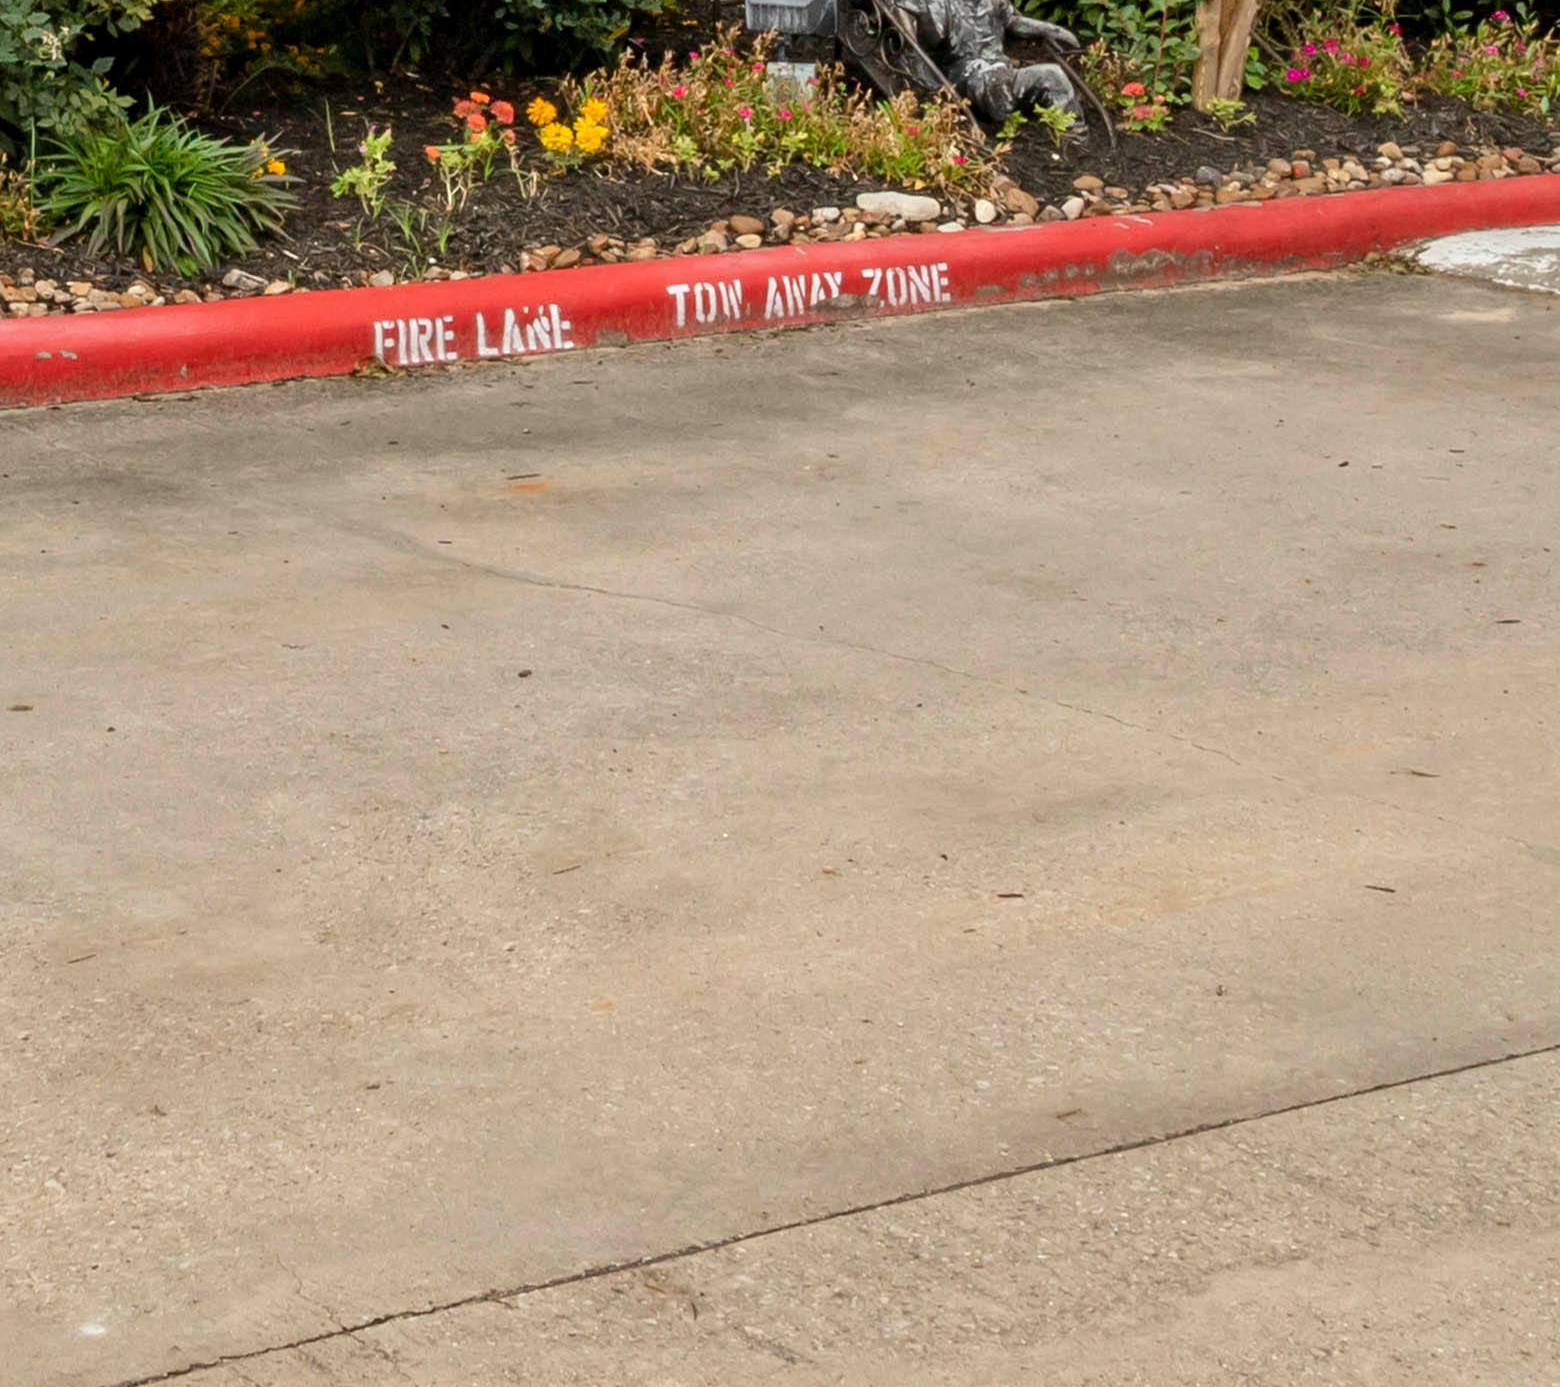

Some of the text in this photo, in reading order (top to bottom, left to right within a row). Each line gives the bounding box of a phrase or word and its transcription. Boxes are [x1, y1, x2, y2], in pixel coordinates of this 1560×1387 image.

[374, 262, 951, 365] FIRE LANE TOW AWAY ZONE
